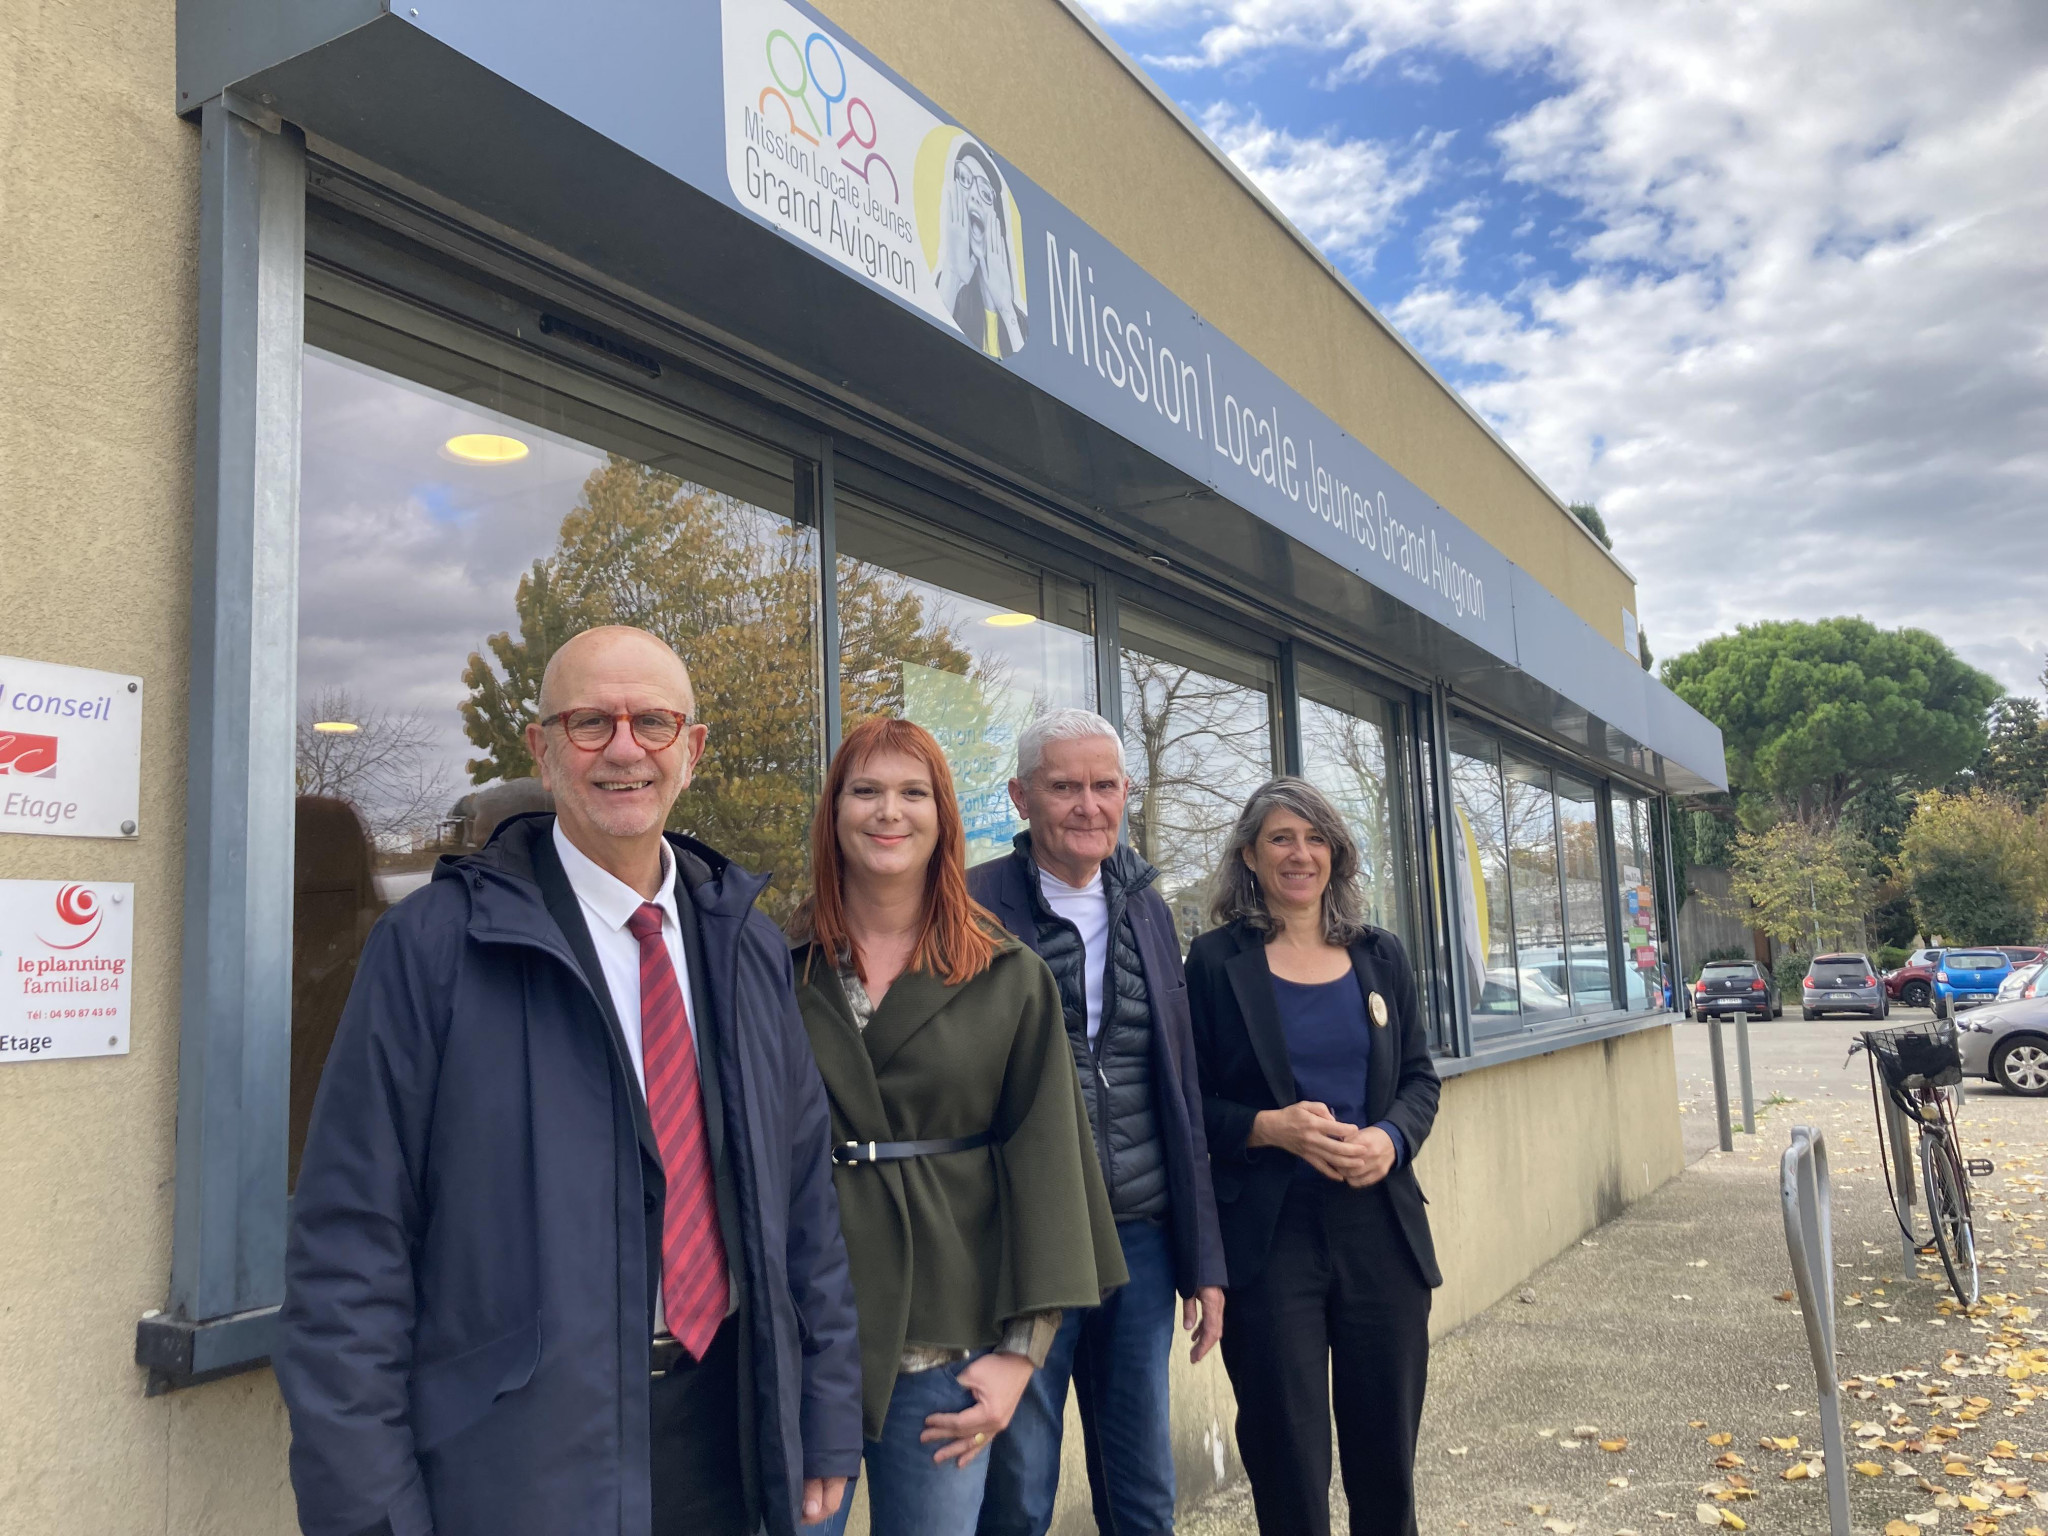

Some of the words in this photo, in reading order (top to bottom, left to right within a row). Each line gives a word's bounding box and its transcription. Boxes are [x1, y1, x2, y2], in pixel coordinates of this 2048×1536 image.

[745, 106, 809, 177] Mission
[813, 151, 860, 209] Locale
[863, 187, 913, 243] Jeunes
[746, 146, 822, 237] Grand
[830, 199, 917, 294] Avignon
[1046, 230, 1203, 440] Mission
[1206, 353, 1299, 502] Locale
[1305, 439, 1376, 552] Jeunes
[1377, 490, 1430, 586] Grand
[1431, 528, 1486, 622] Avignon
[12, 692, 111, 721] conseil
[4, 792, 78, 824] Etage
[18, 956, 35, 972] le
[37, 955, 126, 977] planning
[24, 976, 98, 994] familial
[100, 978, 119, 992] 84
[50, 1010, 61, 1019] 04
[64, 1009, 76, 1018] 90
[78, 1008, 90, 1017] 87
[92, 1008, 103, 1017] 43
[106, 1007, 117, 1016] 69
[0, 1035, 52, 1054] Etage
